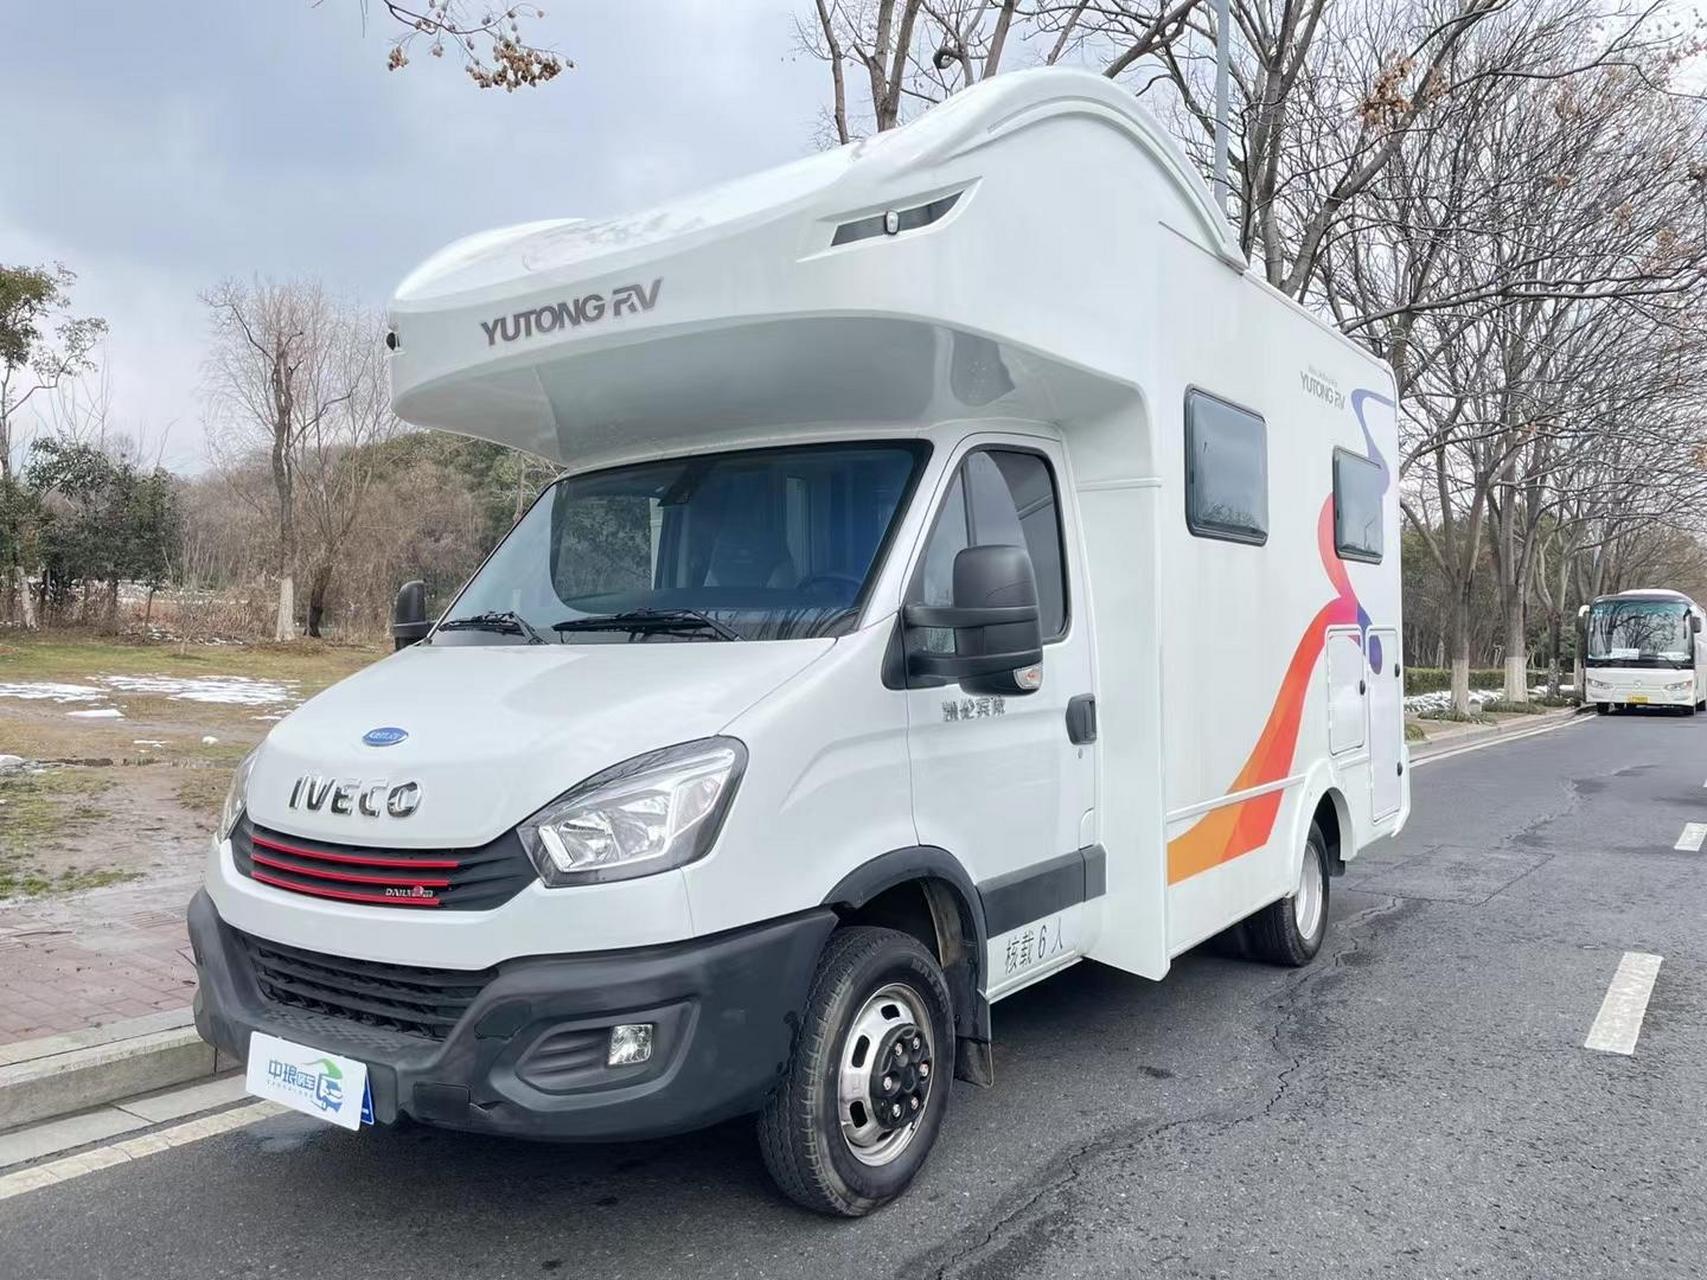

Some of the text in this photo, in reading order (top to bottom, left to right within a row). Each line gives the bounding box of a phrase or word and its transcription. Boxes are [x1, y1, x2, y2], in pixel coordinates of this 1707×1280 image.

[481, 277, 663, 346] YUTONG RV
[1300, 370, 1334, 404] YUTONG
[1334, 390, 1345, 410] RV
[289, 774, 422, 818] IVECO
